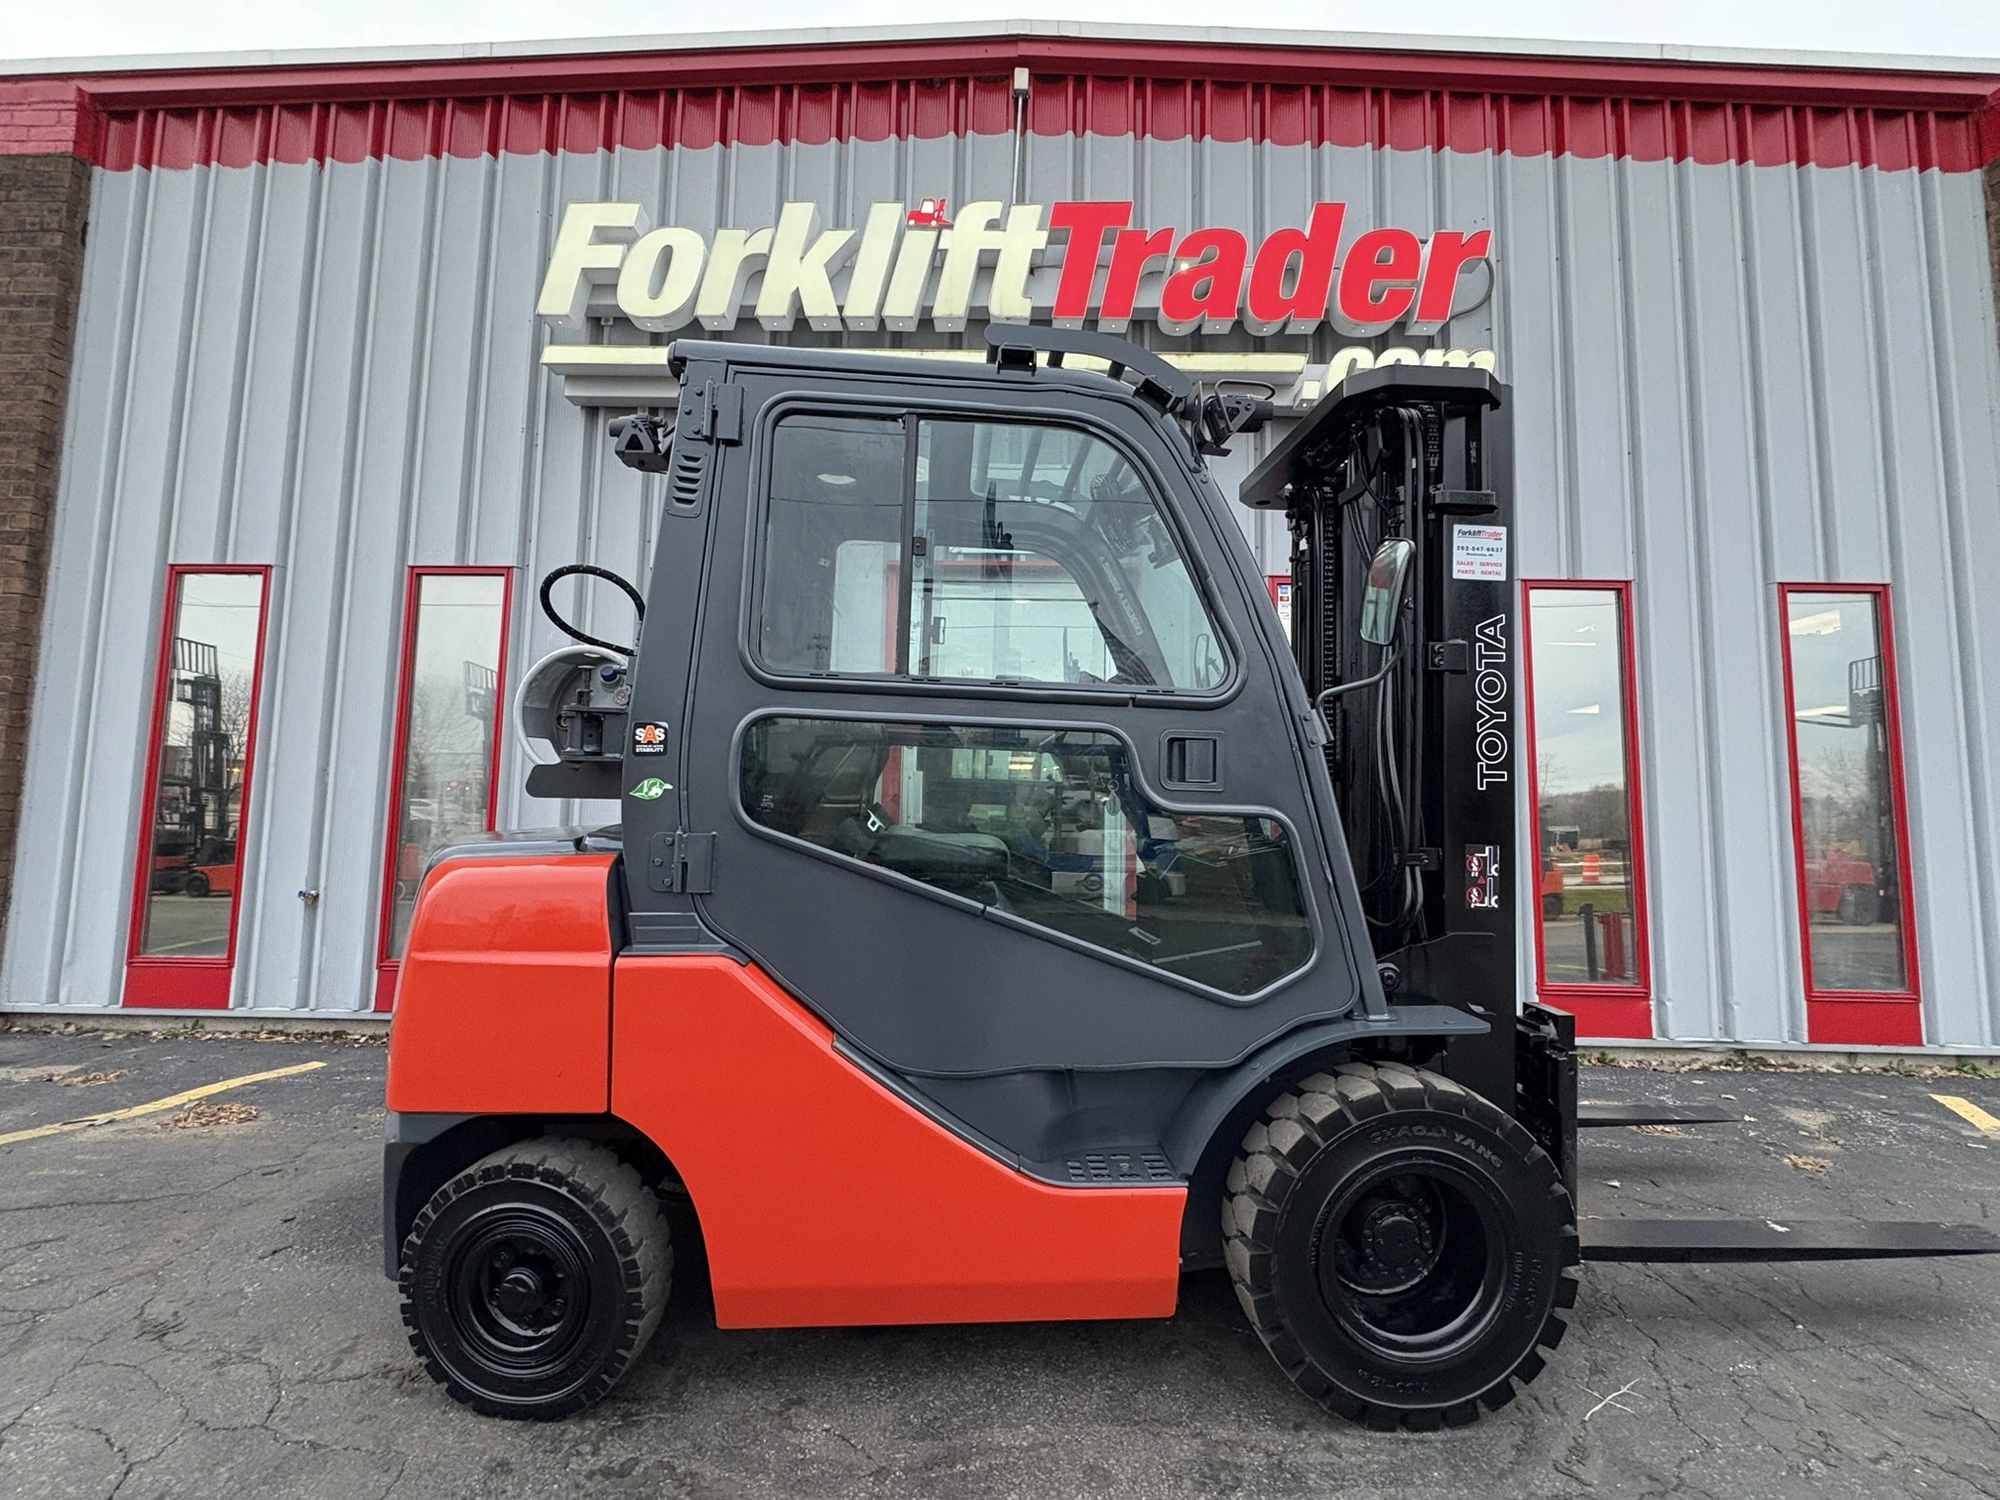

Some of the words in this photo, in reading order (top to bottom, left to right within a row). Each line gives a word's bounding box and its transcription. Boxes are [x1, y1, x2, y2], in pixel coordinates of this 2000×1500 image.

[537, 198, 1492, 323] ForkliftTrader
[1457, 529, 1503, 538] ForkliftTrader
[635, 726, 665, 743] SAS
[1475, 614, 1507, 790] TOYOTA
